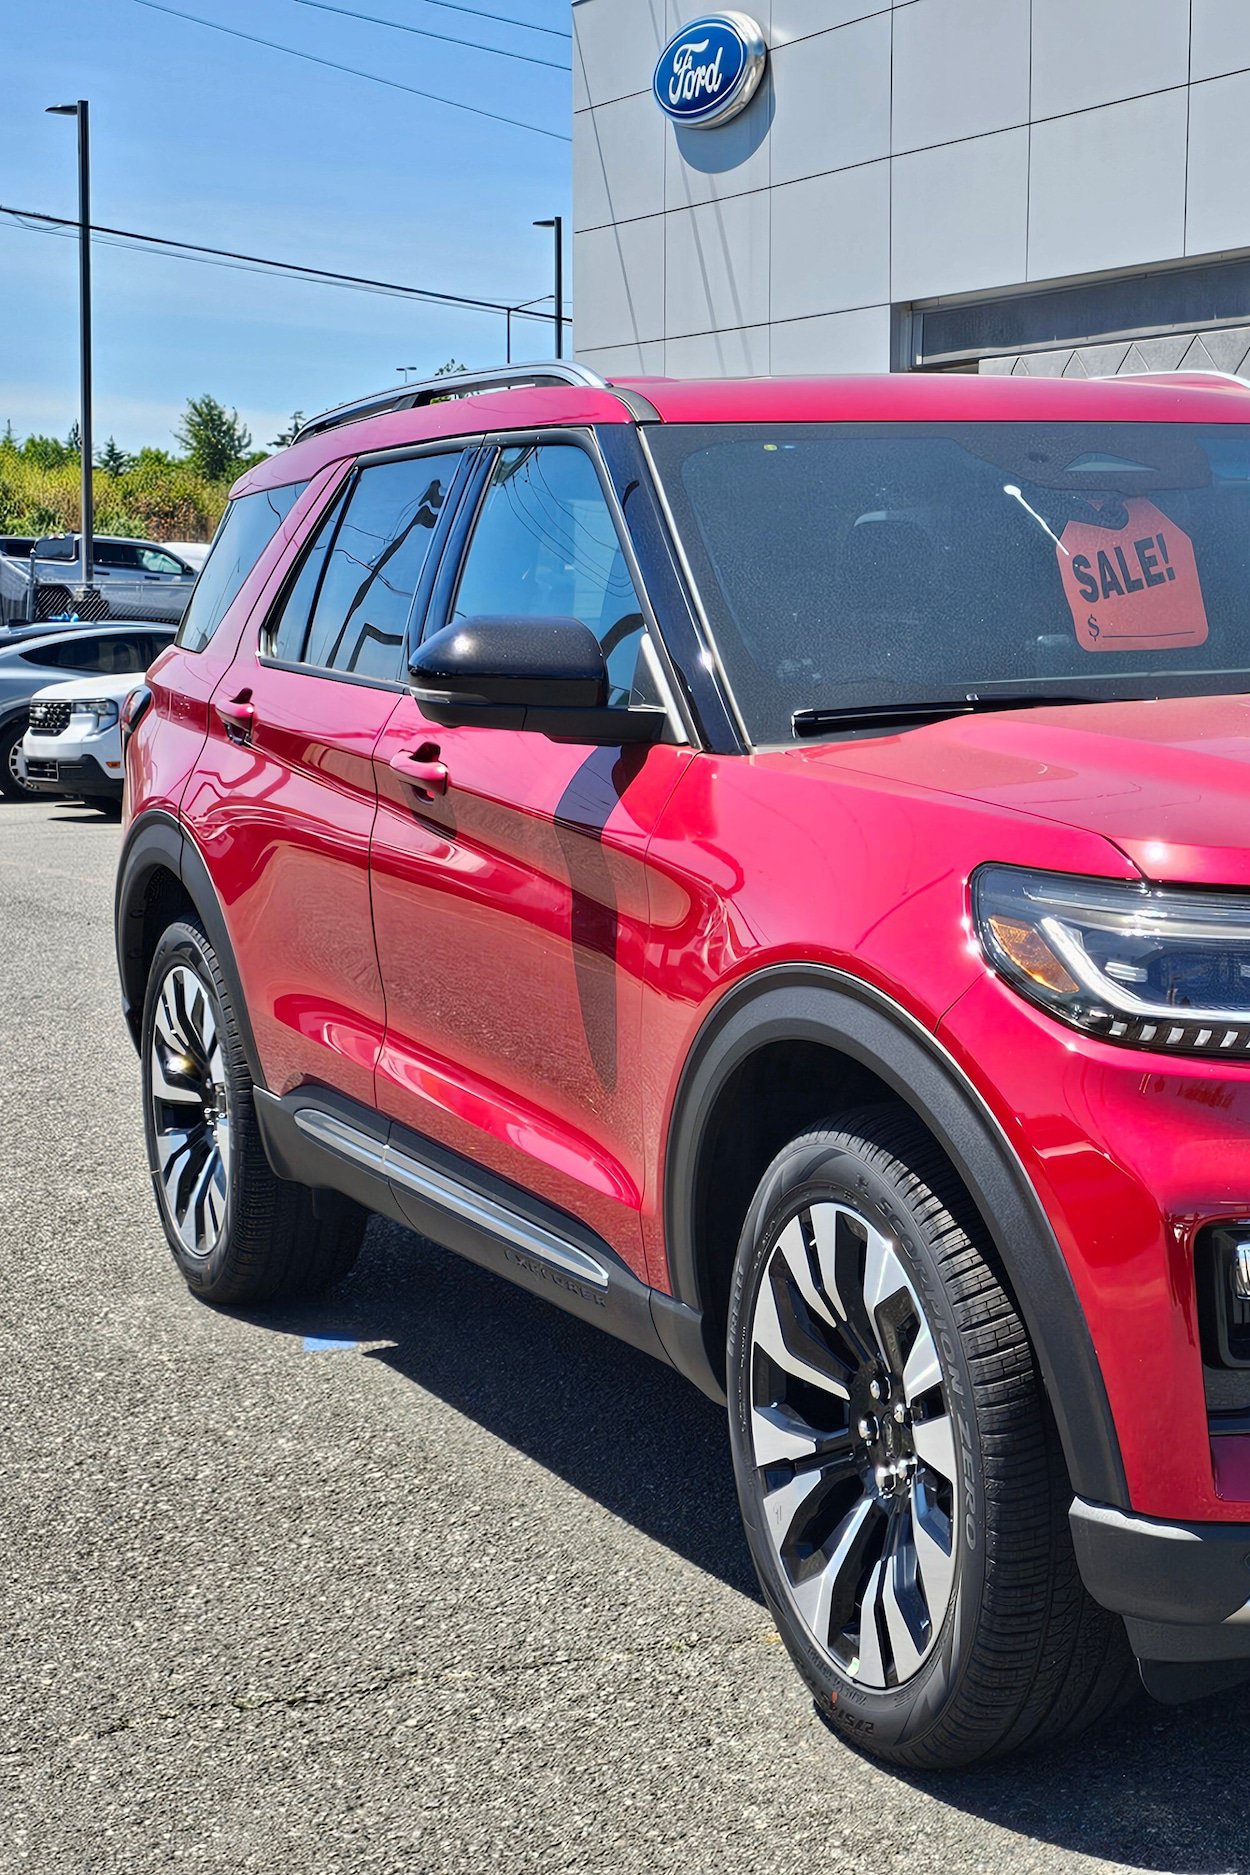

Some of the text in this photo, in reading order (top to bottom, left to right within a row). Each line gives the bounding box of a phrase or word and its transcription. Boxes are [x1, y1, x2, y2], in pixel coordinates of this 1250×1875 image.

[668, 38, 724, 105] Ford
[1072, 533, 1176, 603] SALE!
[1087, 614, 1100, 641] $
[957, 1413, 976, 1550] ZERO
